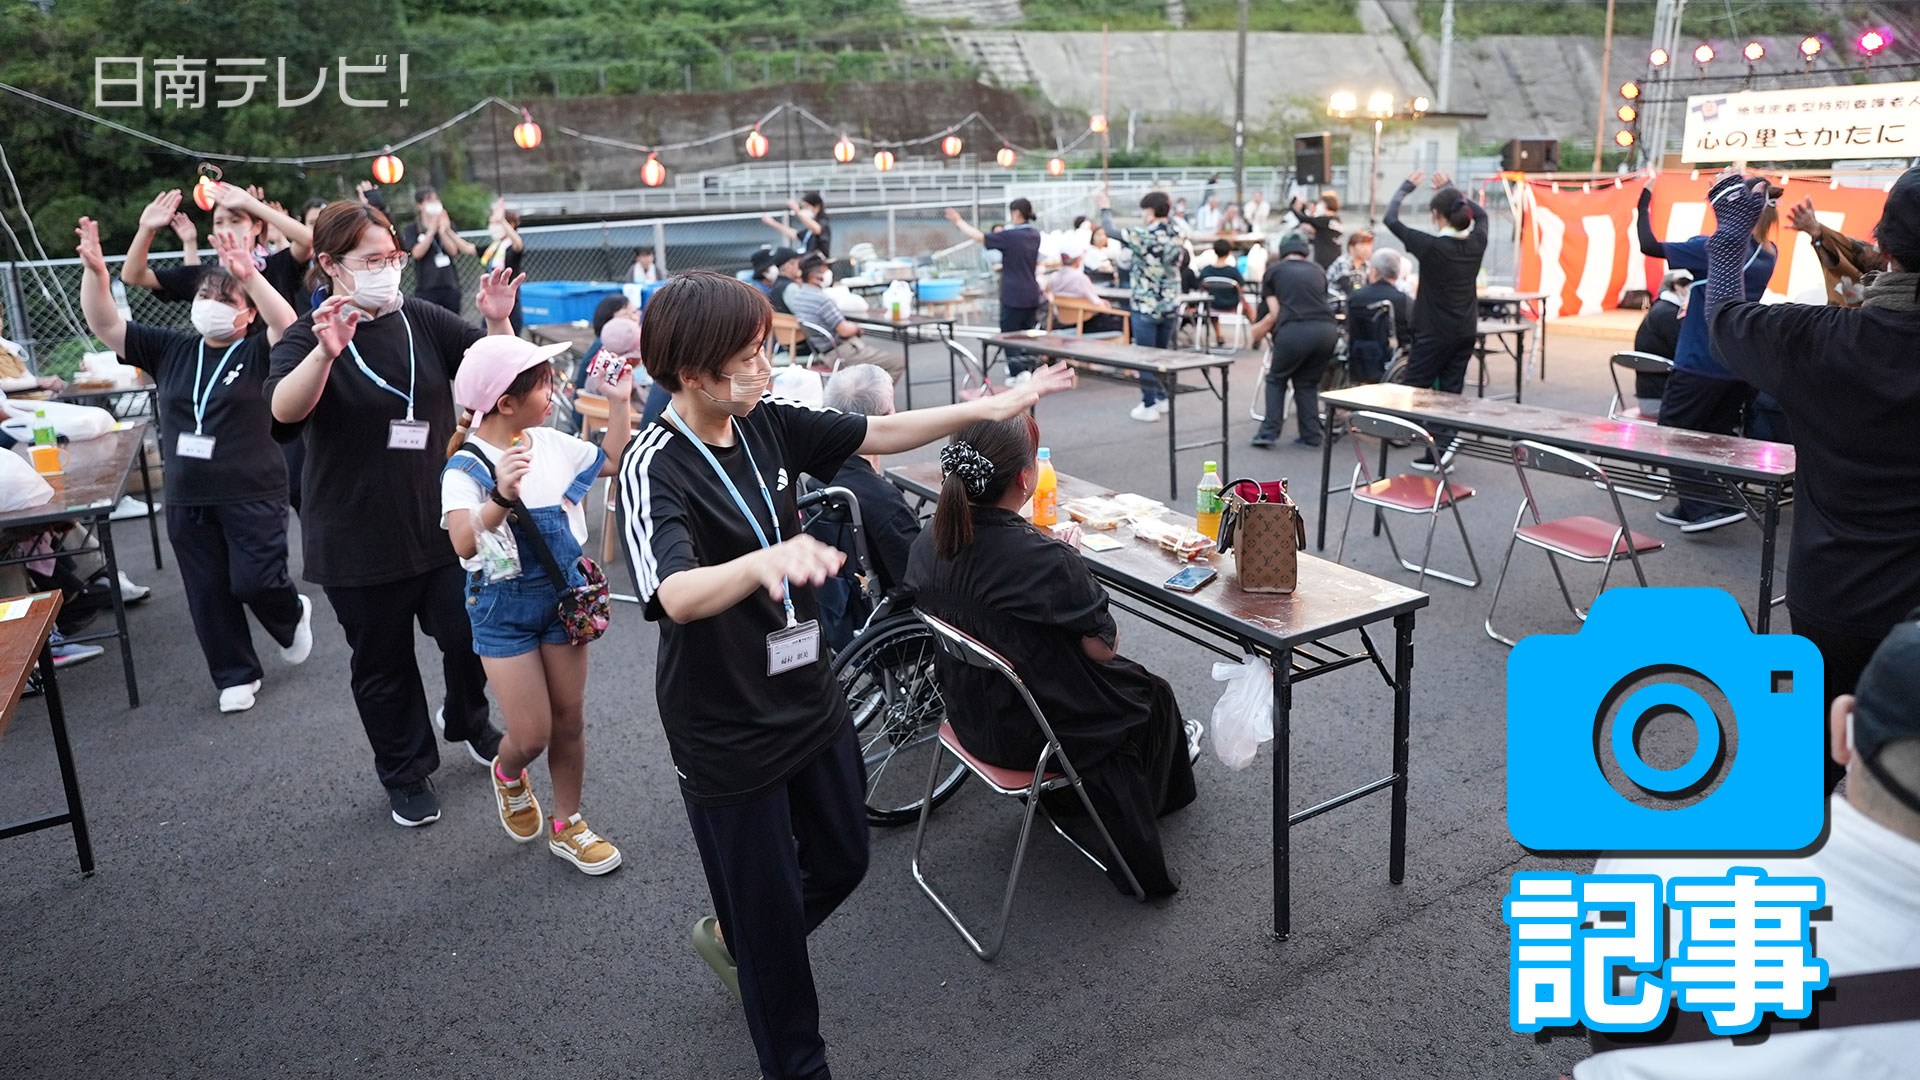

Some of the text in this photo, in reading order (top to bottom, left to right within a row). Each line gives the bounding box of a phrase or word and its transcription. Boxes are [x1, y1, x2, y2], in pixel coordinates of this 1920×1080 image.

[1696, 124, 1906, 150] 心の里さかたに
